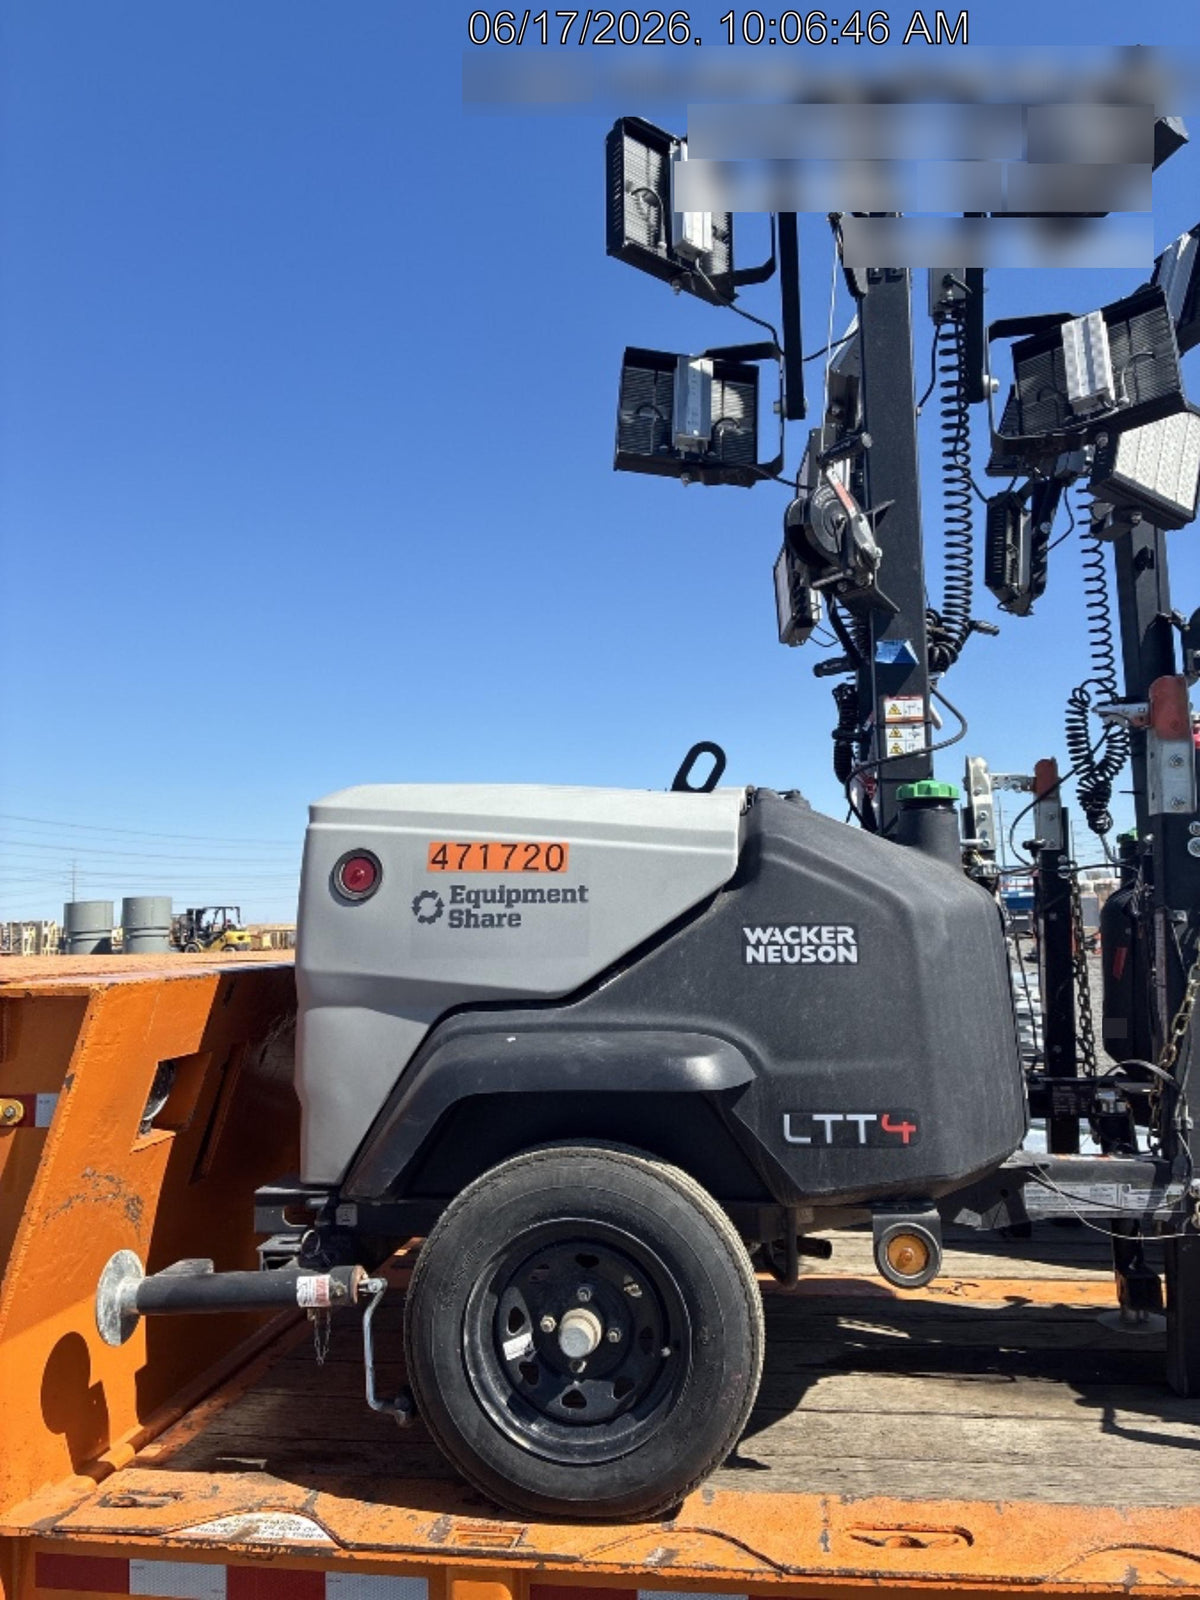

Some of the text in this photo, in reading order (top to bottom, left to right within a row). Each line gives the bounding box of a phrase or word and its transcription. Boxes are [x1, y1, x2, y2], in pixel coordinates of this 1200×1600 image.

[431, 843, 565, 872] 471720
[450, 885, 589, 909] Equipment
[448, 908, 522, 929] Share
[743, 925, 857, 945] WACKER
[746, 945, 858, 964] NEUSON
[783, 1114, 917, 1144] LTT4
